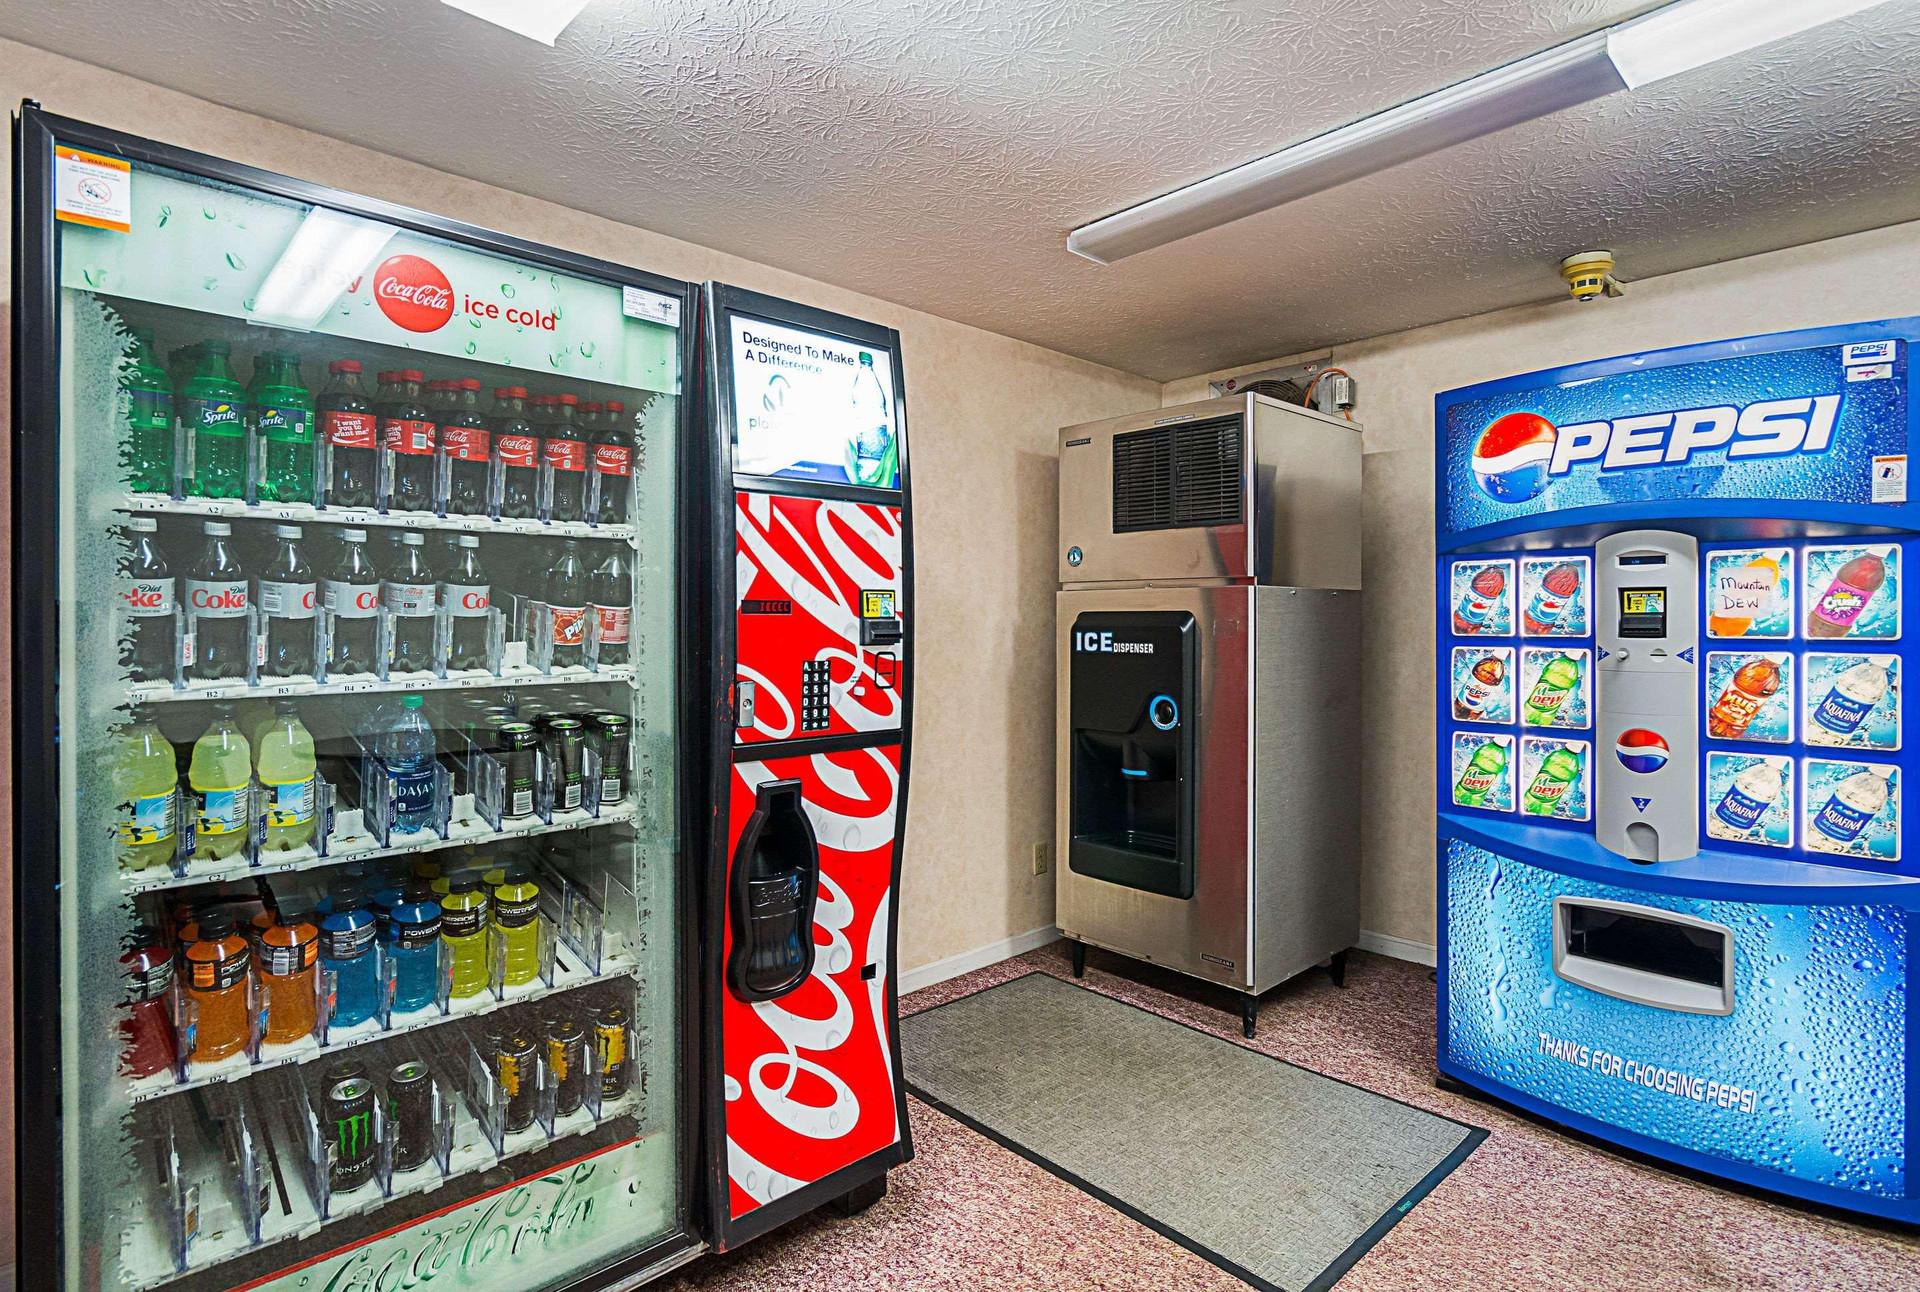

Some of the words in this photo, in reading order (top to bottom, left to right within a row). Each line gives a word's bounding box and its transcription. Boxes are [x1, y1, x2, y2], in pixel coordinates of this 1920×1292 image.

[378, 276, 451, 310] Coca-Cola
[464, 294, 499, 318] ice
[506, 307, 556, 330] cold
[742, 331, 802, 356] Designed
[805, 346, 820, 358] To
[822, 350, 854, 366] Make
[1850, 343, 1888, 354] PEPSI
[745, 349, 754, 362] A
[758, 352, 823, 375] Difference
[202, 410, 236, 424] Sprite
[1548, 394, 1843, 474] PEPSI
[124, 588, 162, 608] ke
[138, 584, 162, 592] Diet
[192, 588, 246, 609] Coke
[1724, 595, 1759, 610] DEW
[1076, 632, 1113, 652] ICE
[1113, 642, 1154, 654] DISPENSER
[804, 662, 809, 670] A
[804, 674, 808, 682] B
[814, 673, 819, 681] 3
[803, 686, 808, 694] C
[813, 685, 818, 693] 5
[823, 684, 828, 692] 6
[1465, 685, 1490, 698] PEPSI
[803, 698, 808, 706] D
[813, 697, 818, 705] 7
[823, 696, 828, 705] 8
[1724, 692, 1756, 714] MUG
[1823, 696, 1864, 722] AQUAFINA
[803, 710, 808, 718] E
[813, 709, 818, 717] 9
[823, 708, 828, 716] 0
[802, 722, 808, 730] F
[1724, 794, 1760, 818] AQUAFINA
[1823, 804, 1864, 831] AQUAFINA
[1537, 1032, 1588, 1067] THANKS
[1590, 1050, 1622, 1077] FOR
[1624, 1060, 1704, 1101] CHOOSING
[1706, 1080, 1756, 1114] PEPSI
